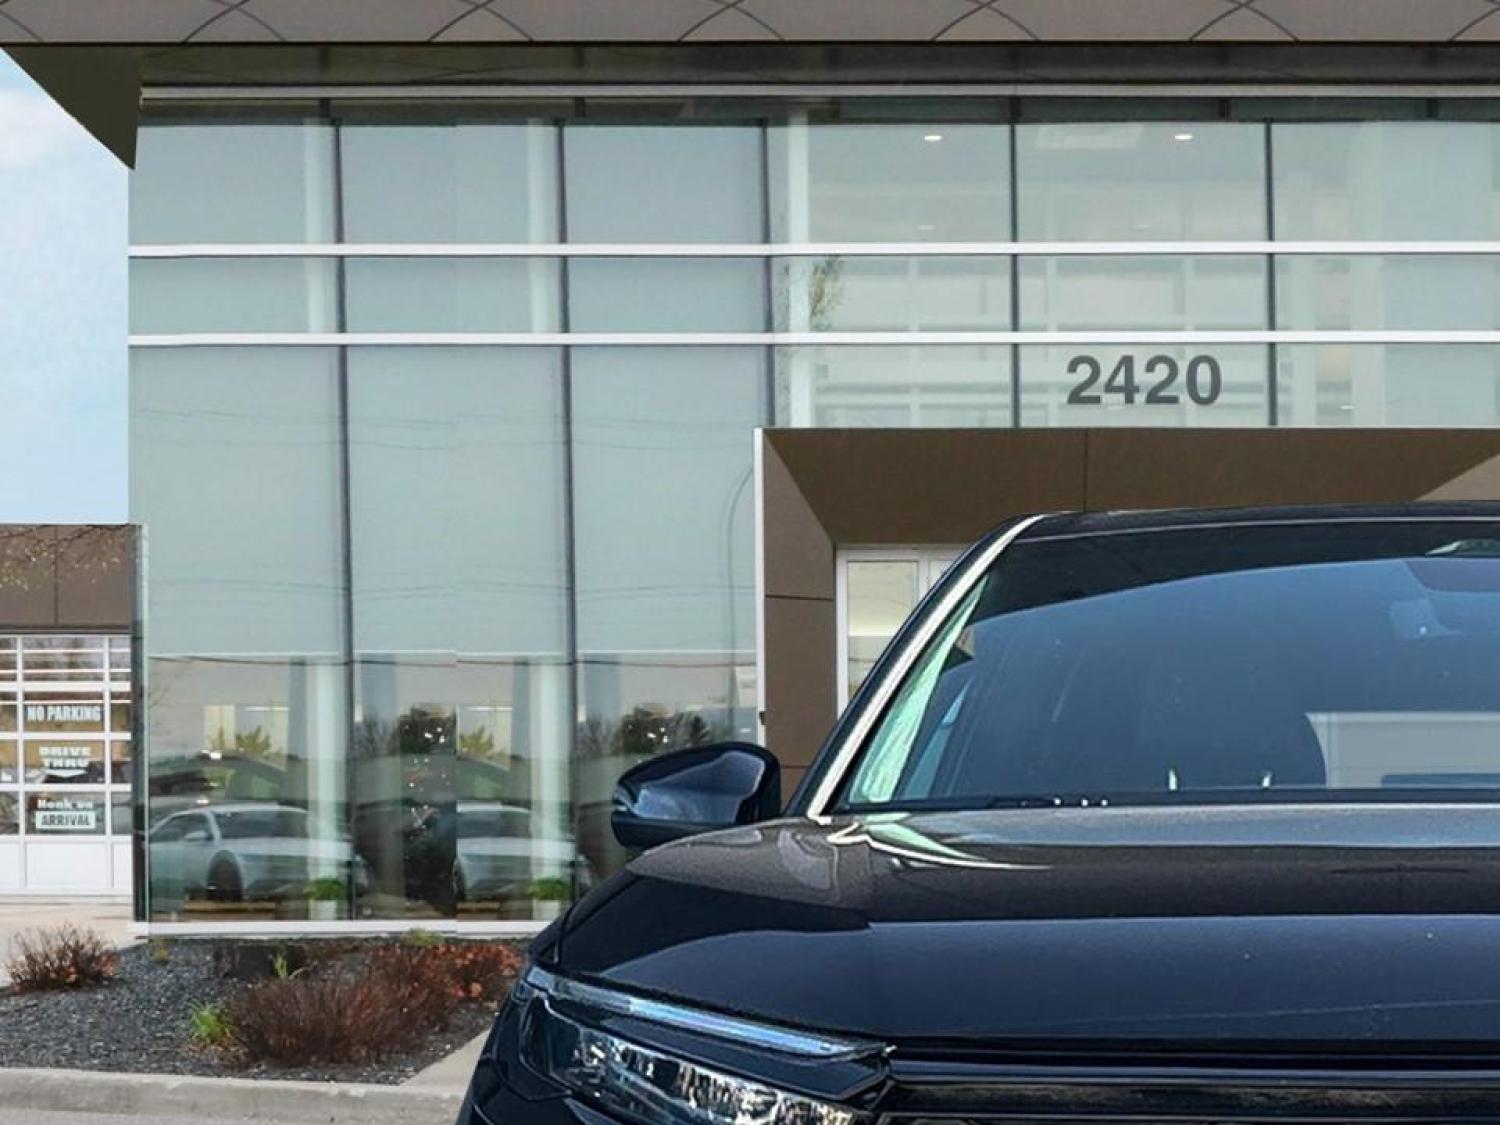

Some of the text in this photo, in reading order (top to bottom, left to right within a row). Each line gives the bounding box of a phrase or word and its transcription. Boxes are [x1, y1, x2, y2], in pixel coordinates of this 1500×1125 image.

[1066, 354, 1222, 406] 2420
[27, 705, 101, 721] NO PARKING
[41, 814, 91, 825] ARRIVAL
